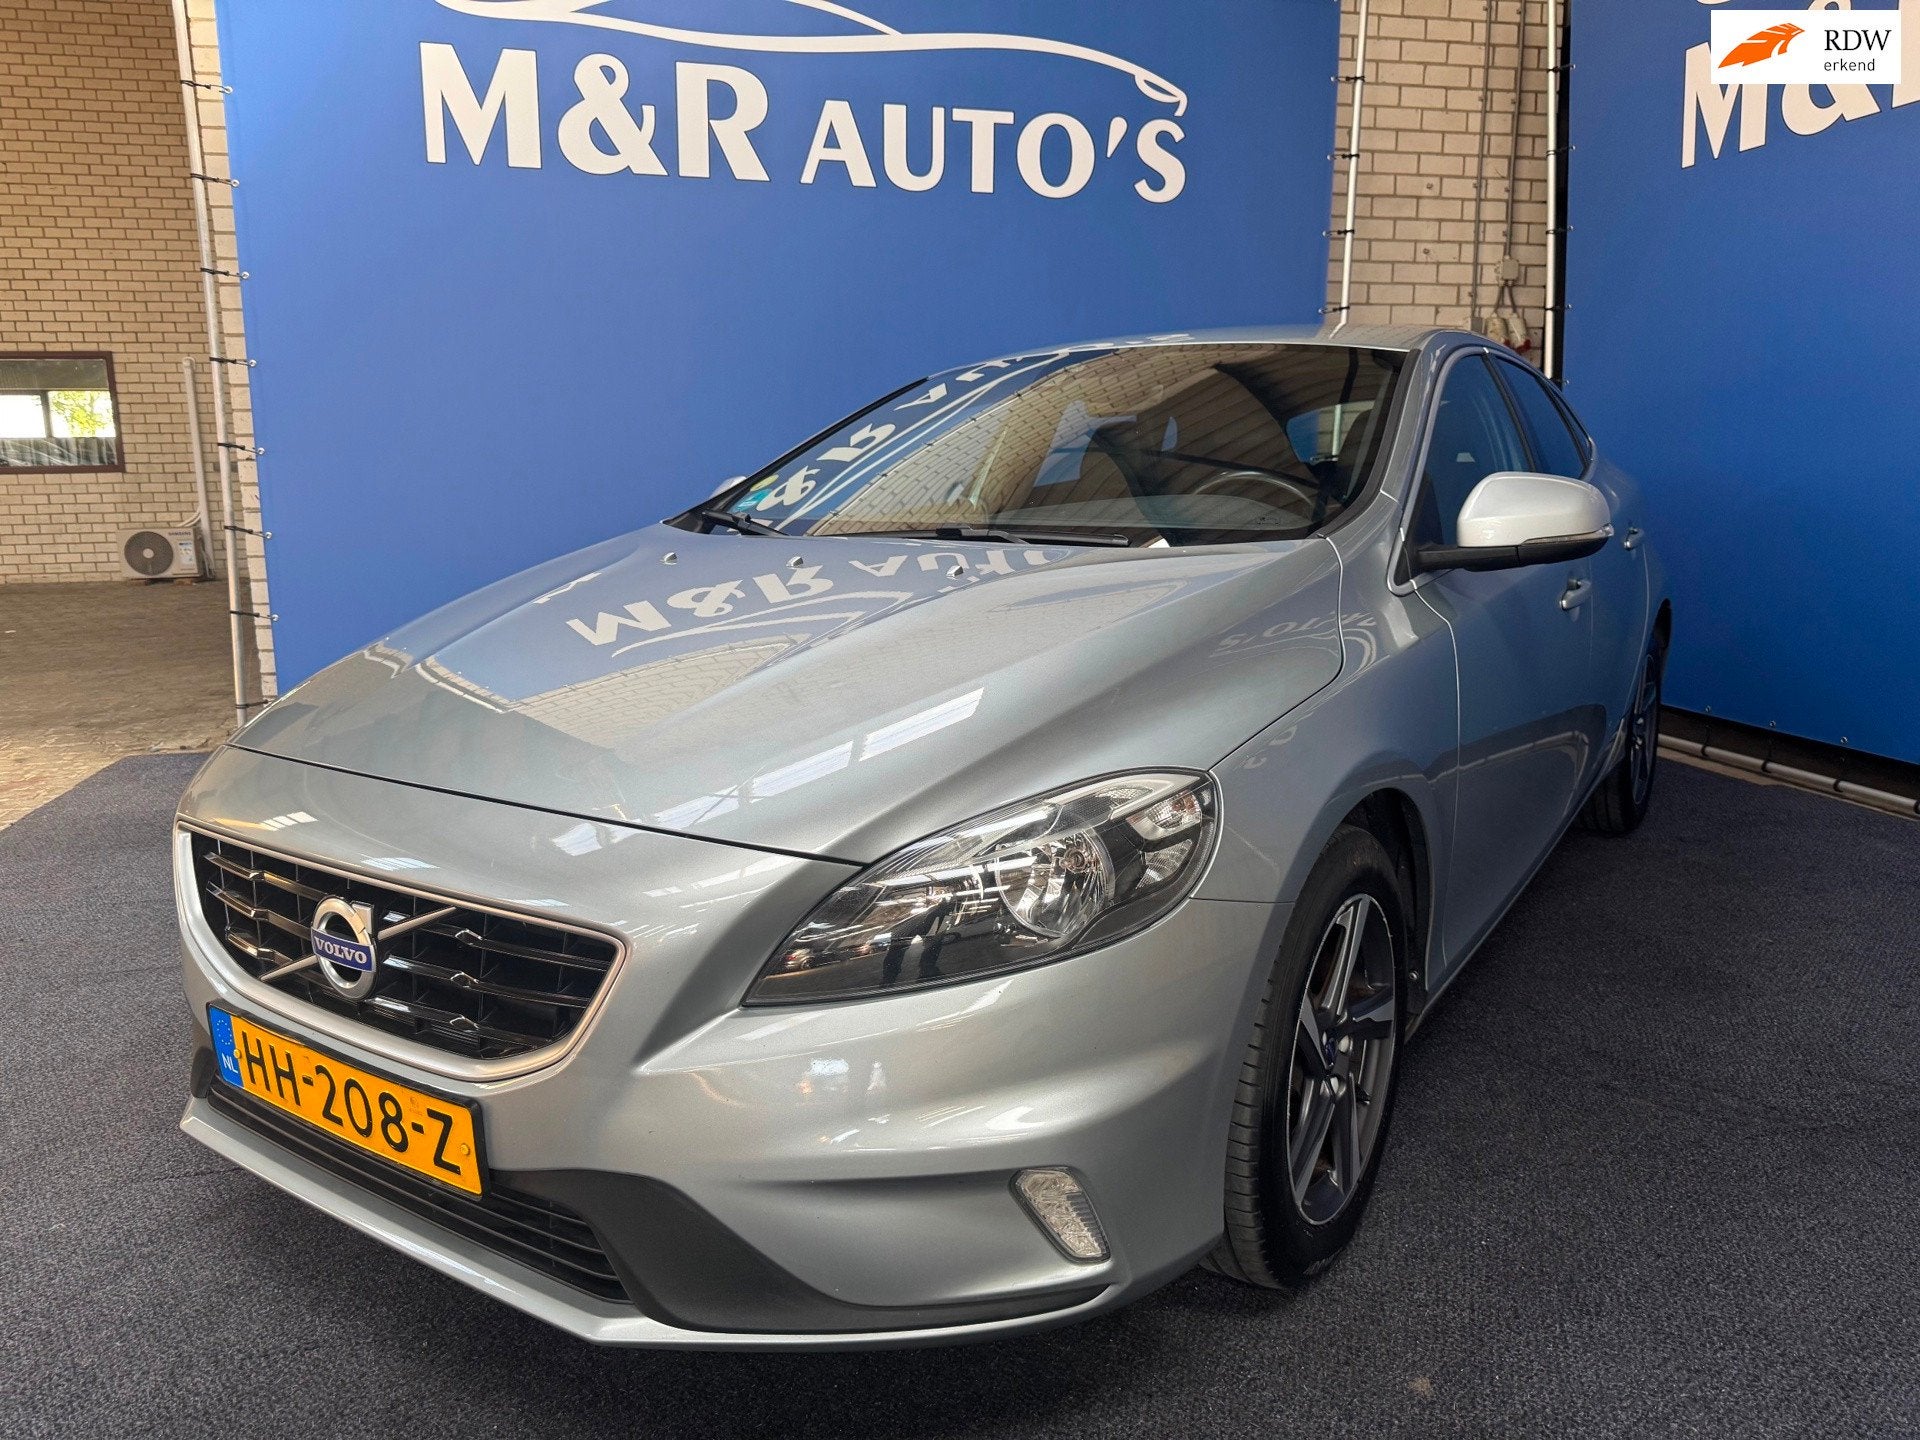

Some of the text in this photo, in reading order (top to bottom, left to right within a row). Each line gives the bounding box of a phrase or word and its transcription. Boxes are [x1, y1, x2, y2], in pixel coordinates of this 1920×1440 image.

[418, 41, 1187, 203] M&R AUTO'S
[314, 936, 368, 964] VOLVO
[221, 1052, 239, 1074] NL
[241, 1030, 462, 1176] HH-208-Z
